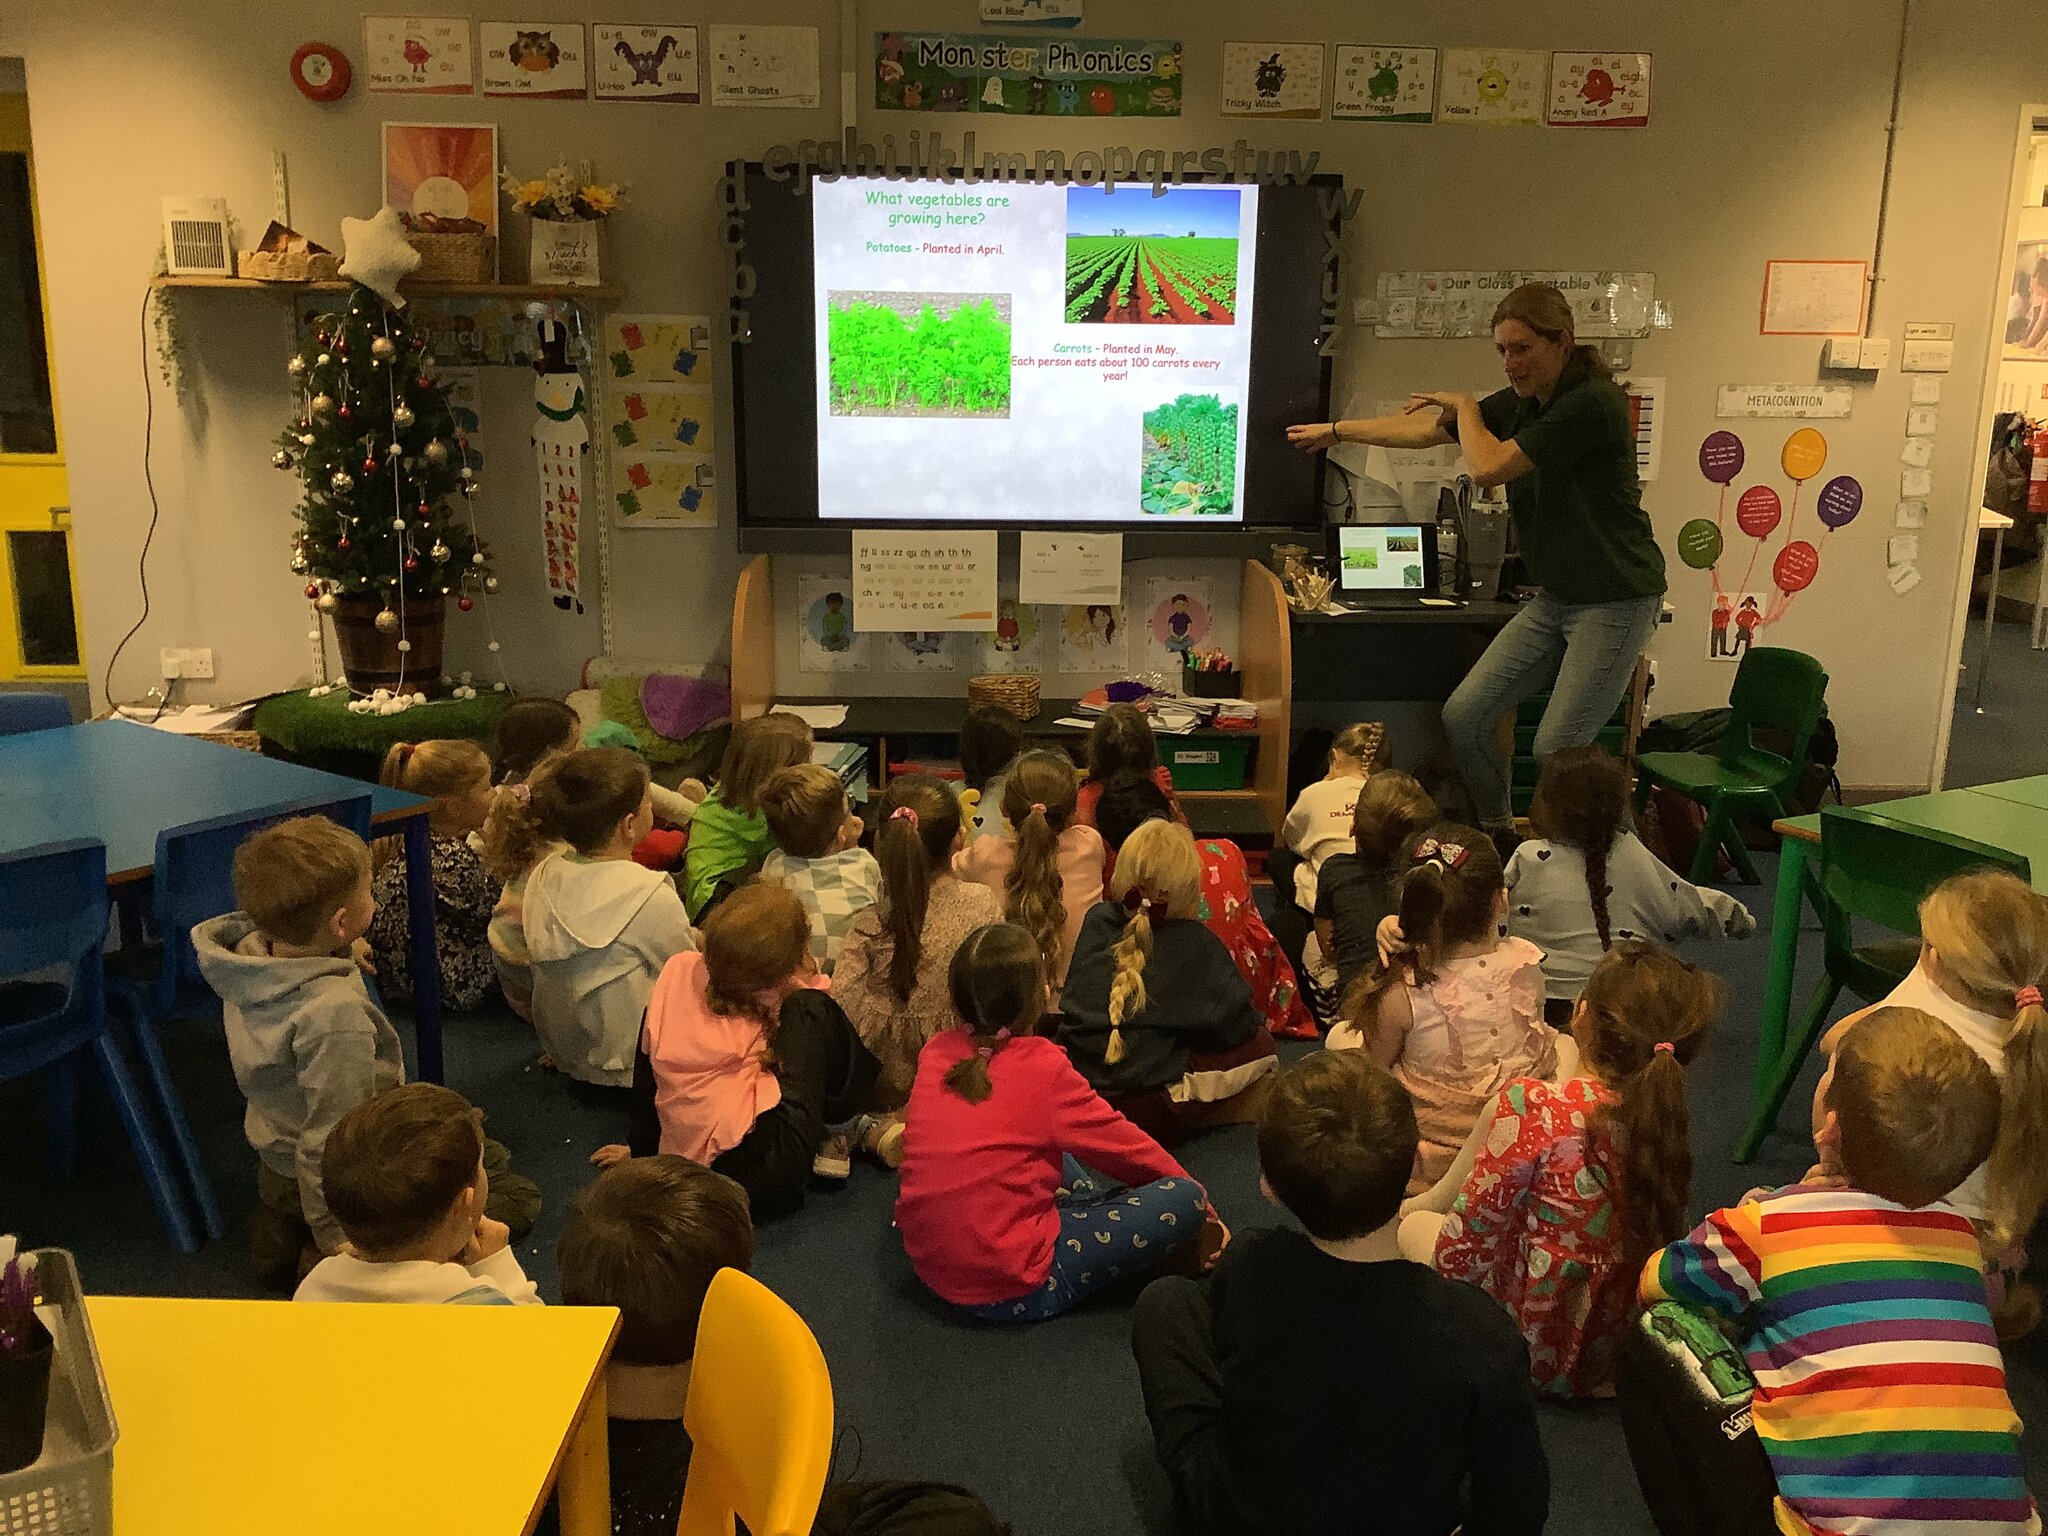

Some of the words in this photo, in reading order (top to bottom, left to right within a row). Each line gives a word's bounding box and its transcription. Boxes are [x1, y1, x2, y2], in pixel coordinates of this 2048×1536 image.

[1005, 7, 1025, 16] Blue
[641, 29, 658, 39] ew
[490, 51, 505, 60] ow
[563, 52, 578, 62] ou
[675, 48, 692, 59] ue
[1047, 44, 1153, 74] Phonics
[610, 63, 618, 72] u
[1610, 58, 1621, 69] ei
[1569, 65, 1585, 77] ay
[371, 75, 392, 83] Miss
[395, 75, 409, 83] Oh
[412, 75, 426, 83] No
[667, 72, 683, 83] eu
[484, 79, 511, 88] Brown
[516, 79, 532, 88] Owl
[598, 82, 626, 91] U-Hoo
[1560, 79, 1578, 89] a-e
[748, 86, 780, 96] Ghosts
[1225, 98, 1252, 110] Tricky
[1255, 100, 1282, 108] Witch
[1557, 95, 1566, 103] a
[1335, 101, 1362, 111] Green
[1365, 103, 1395, 115] Froggy
[1445, 104, 1471, 114] Yellow
[1474, 106, 1480, 115] I
[1552, 107, 1578, 119] Angry
[1581, 107, 1598, 116] Red
[1601, 108, 1608, 116] A
[1620, 101, 1635, 114] ey
[866, 191, 903, 204] What
[908, 192, 982, 209] vegetables
[987, 197, 1010, 207] are
[889, 212, 942, 228] growing
[947, 212, 986, 225] here?
[866, 241, 912, 253] Potatoes
[923, 243, 962, 254] Planted
[965, 244, 975, 254] in
[977, 245, 1005, 257] April.
[1444, 277, 1472, 290] Our
[1477, 276, 1514, 290] Class
[1053, 343, 1092, 354] Carrots
[1103, 343, 1140, 355] Planted
[1143, 344, 1153, 354] in
[1155, 345, 1179, 358] May.
[1011, 356, 1035, 367] Each
[1038, 358, 1072, 369] person
[1074, 358, 1097, 368] eats
[1099, 358, 1127, 368] about
[1131, 358, 1149, 368] 100
[1152, 359, 1190, 369] carrots
[1192, 361, 1221, 372] every
[1103, 371, 1128, 383] year!
[1746, 395, 1824, 407] METACOGNITION
[920, 549, 931, 557] ch
[934, 549, 945, 557] sh
[948, 548, 958, 556] th
[962, 548, 972, 556] th
[860, 563, 872, 572] ng
[942, 563, 952, 571] ur
[967, 563, 976, 571] or
[862, 589, 873, 597] ch
[893, 590, 905, 600] ay
[900, 602, 919, 610] u-e
